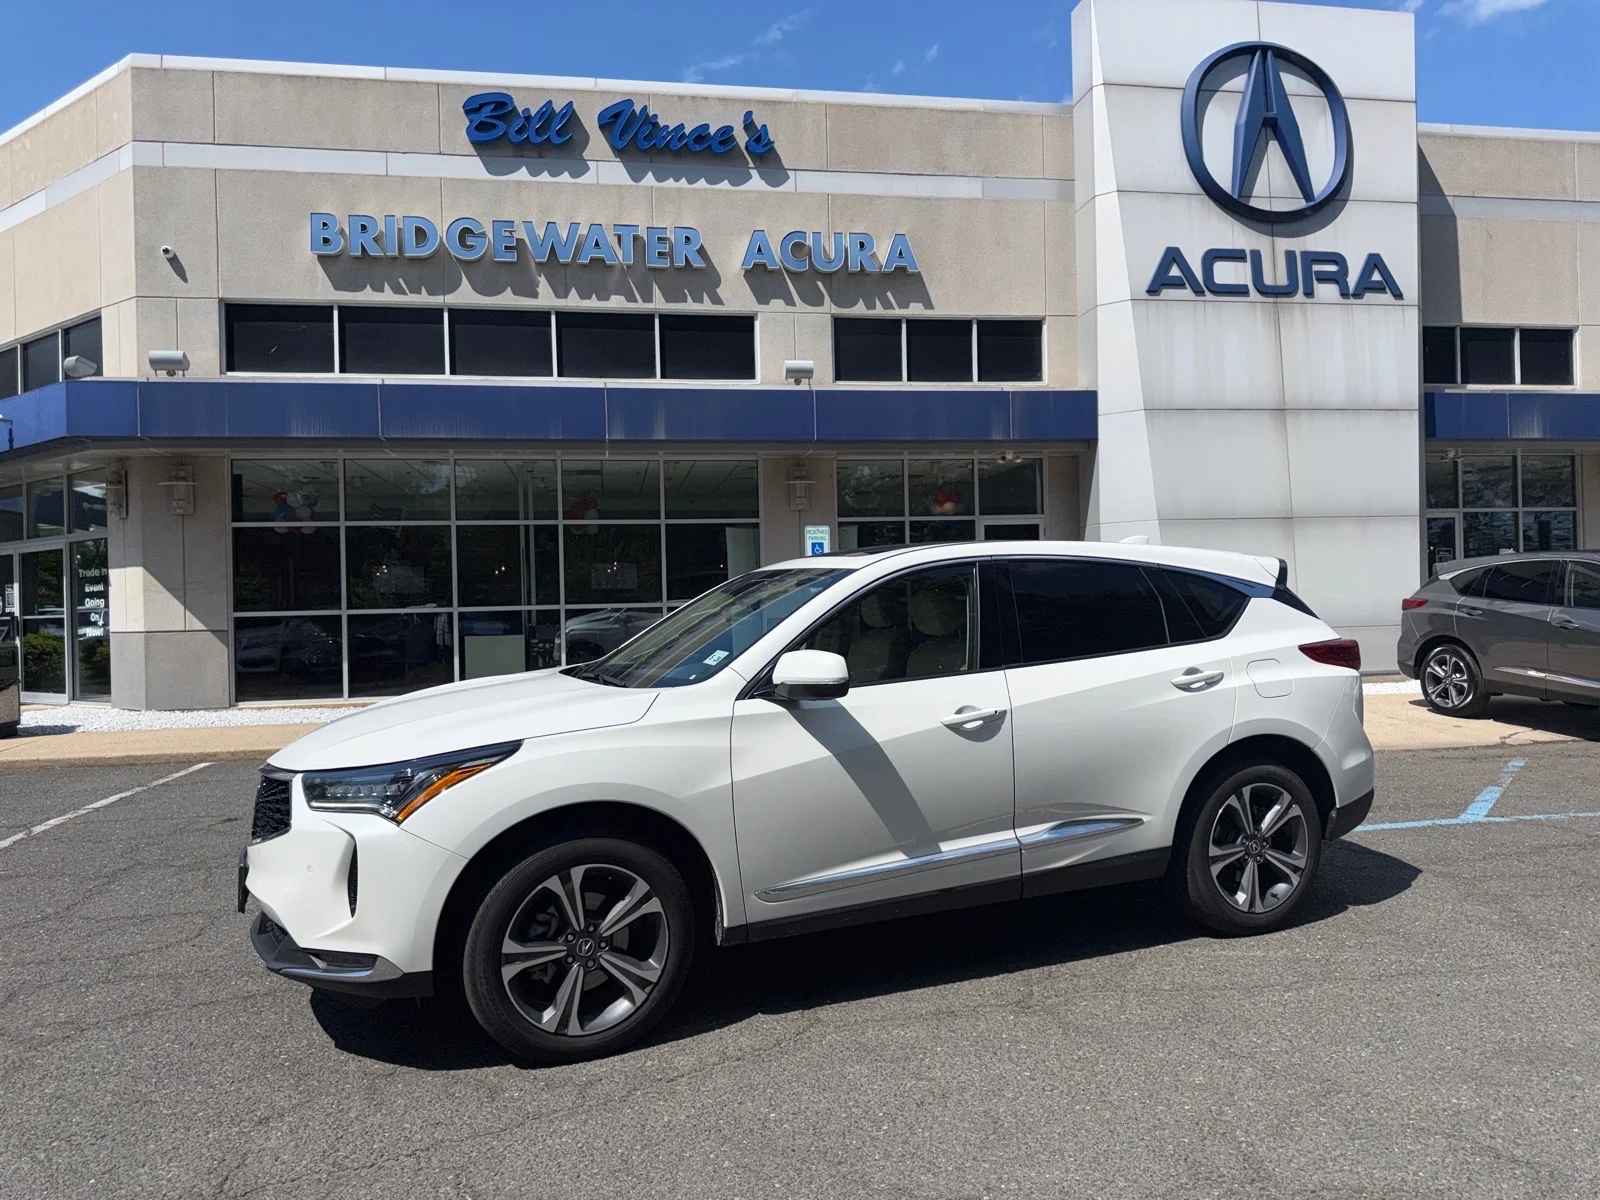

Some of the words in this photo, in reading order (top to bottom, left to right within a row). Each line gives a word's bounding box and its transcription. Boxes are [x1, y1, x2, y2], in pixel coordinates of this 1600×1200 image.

[462, 92, 573, 145] Bill
[597, 98, 774, 156] Vince's
[310, 212, 706, 270] BRIDGEWATER
[741, 229, 920, 275] ACURA
[1146, 246, 1404, 298] ACURA
[78, 567, 100, 578] Trade
[84, 582, 104, 592] Event
[84, 597, 105, 608] Going
[90, 612, 100, 622] On
